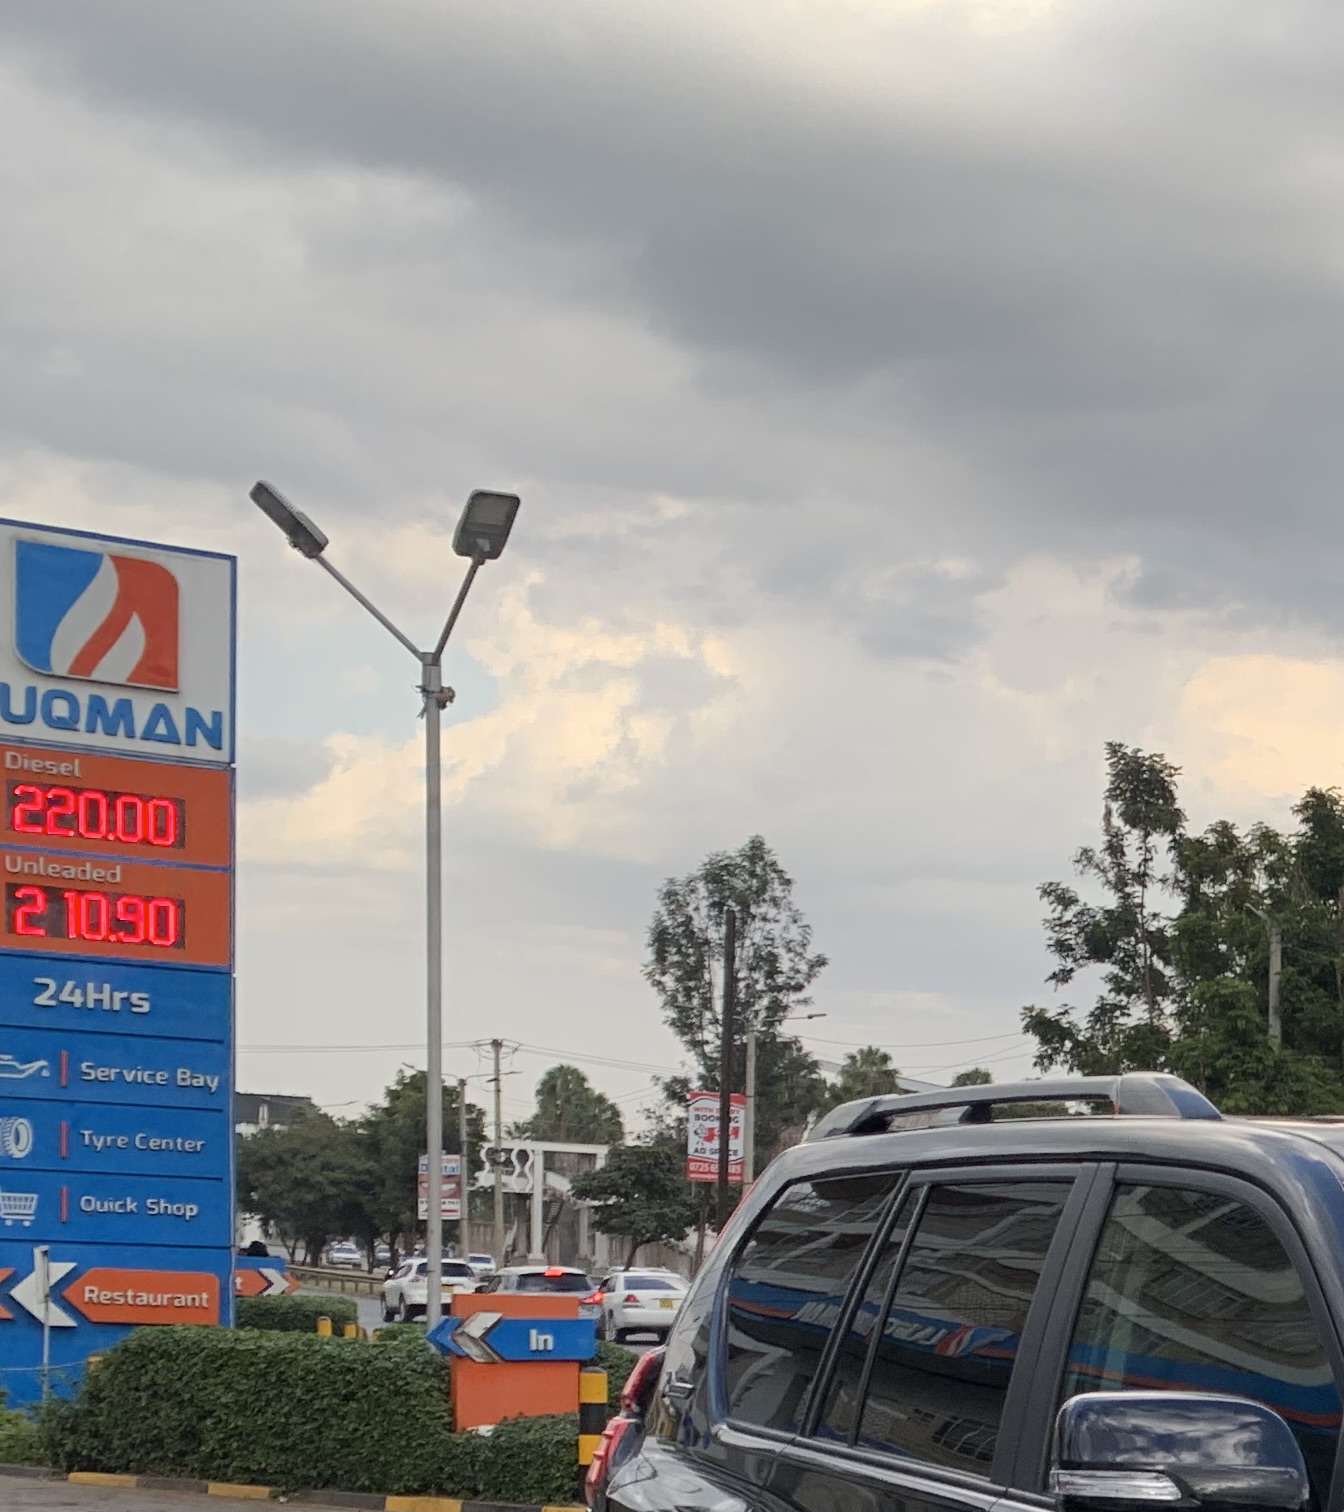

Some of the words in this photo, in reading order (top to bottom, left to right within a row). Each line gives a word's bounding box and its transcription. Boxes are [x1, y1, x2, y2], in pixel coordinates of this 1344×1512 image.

[4, 751, 82, 778] Diesel
[13, 784, 179, 847] 220.00
[5, 855, 122, 883] Unleaded
[33, 977, 151, 1014] 24Hrs
[80, 1061, 169, 1086] Service
[176, 1068, 220, 1093] Bay
[80, 1129, 129, 1151] Tyre
[134, 1133, 206, 1153] Center
[708, 1148, 739, 1157] SPCE
[80, 1195, 139, 1215] Quick
[145, 1197, 199, 1221] Shop
[83, 1285, 209, 1308] Restaurant
[529, 1328, 555, 1351] In
